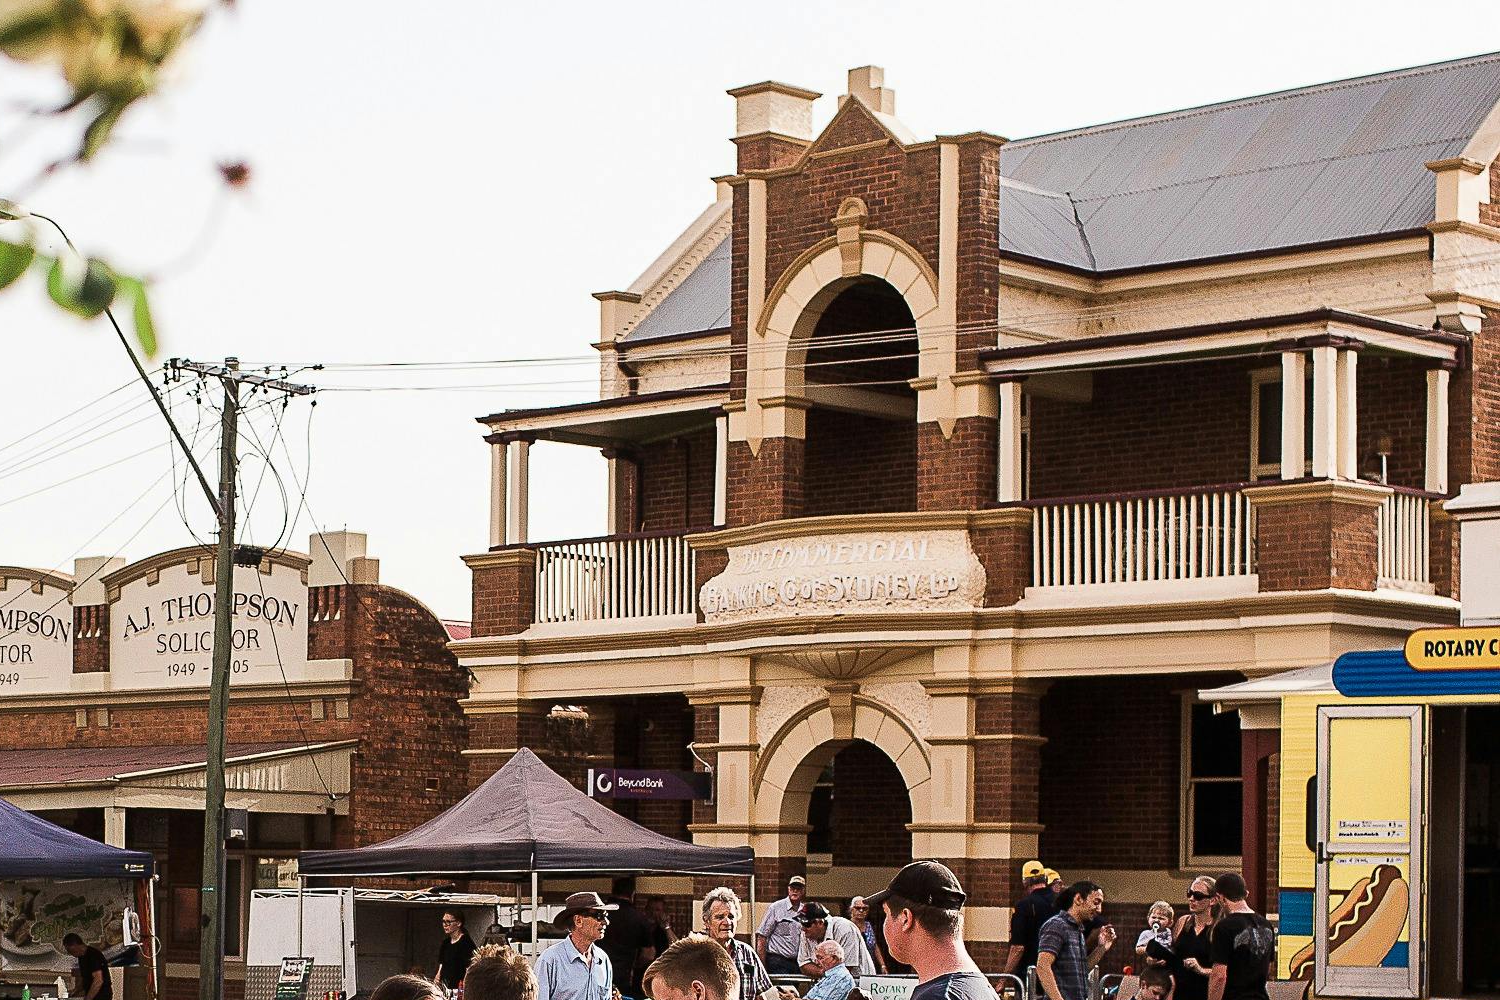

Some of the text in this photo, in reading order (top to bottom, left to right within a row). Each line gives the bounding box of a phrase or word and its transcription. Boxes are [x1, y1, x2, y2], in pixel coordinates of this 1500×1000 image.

[768, 538, 937, 571] COMMERCIAL
[707, 581, 775, 613] BANKING
[827, 574, 919, 602] SYDNEY
[123, 592, 299, 639] A.J. THOPSON
[156, 628, 260, 654] SOLICOR
[1424, 639, 1500, 657] ROTARY C
[167, 662, 196, 677] 1949
[232, 659, 249, 674] 05
[618, 777, 664, 789] Beyond Bank
[870, 983, 908, 995] ROTARY
